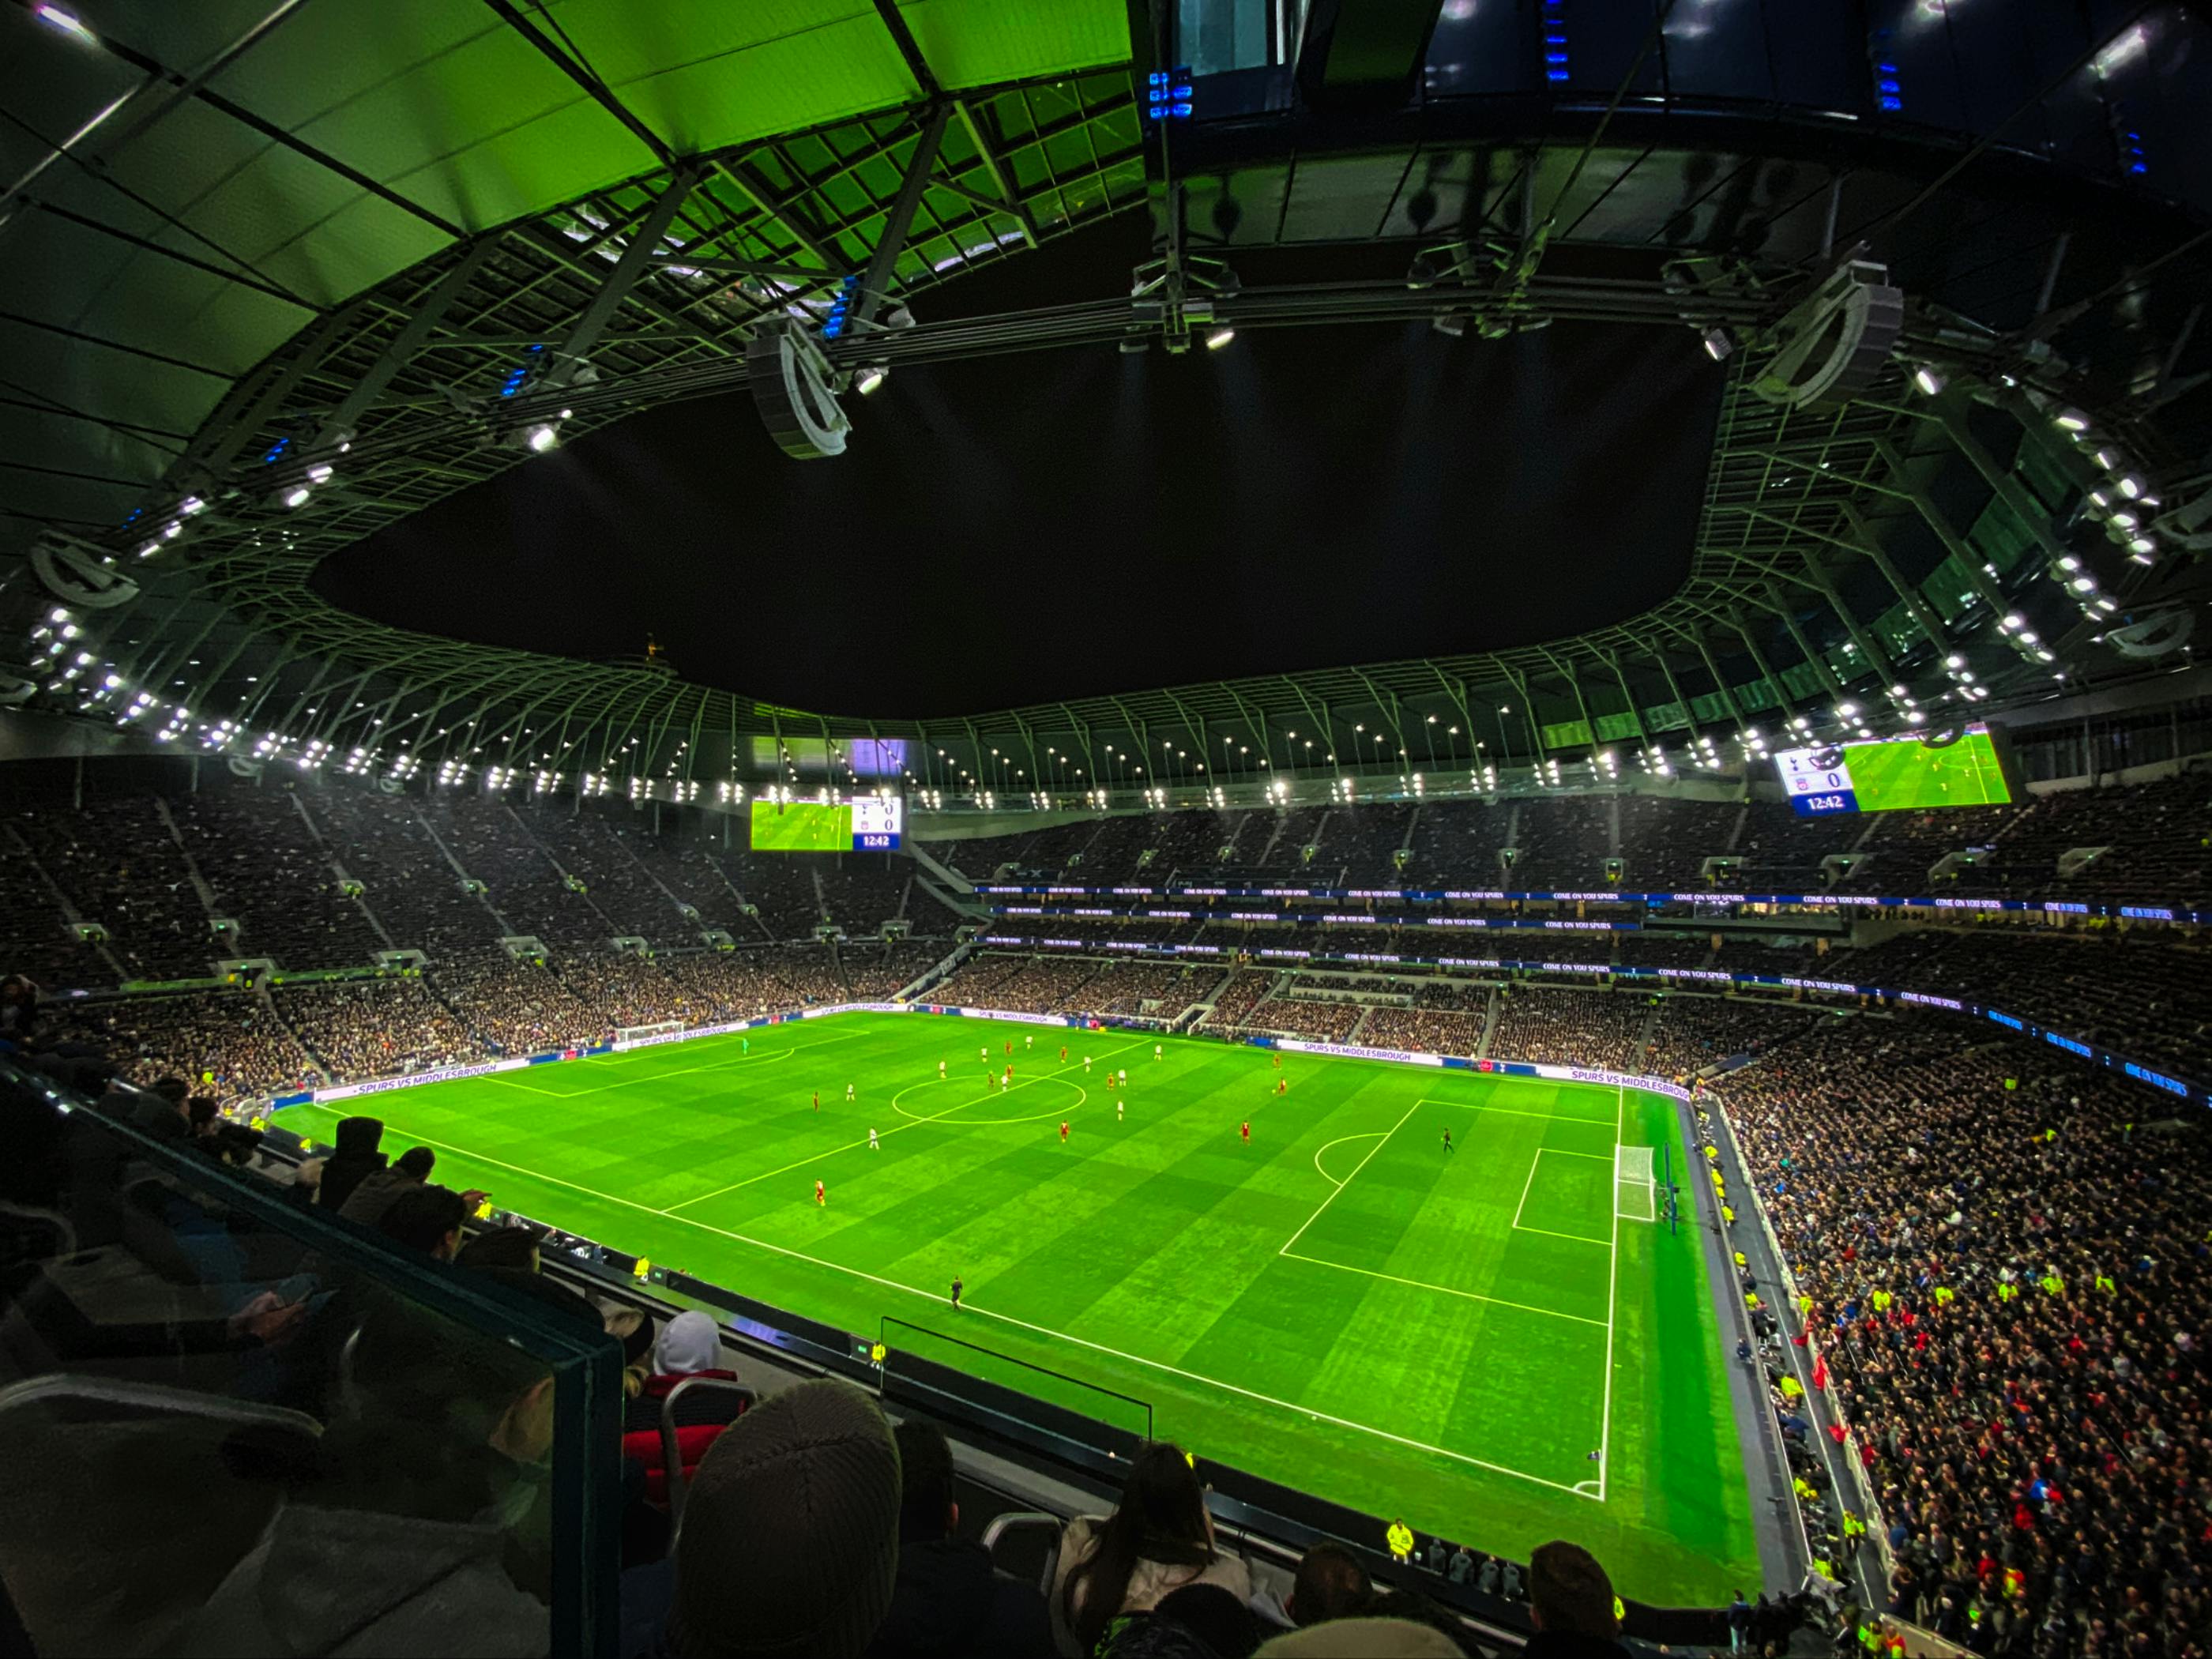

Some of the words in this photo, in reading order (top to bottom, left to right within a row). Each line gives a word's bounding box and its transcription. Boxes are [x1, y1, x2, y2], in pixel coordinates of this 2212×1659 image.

[1828, 773, 1840, 788] 0
[1807, 795, 1845, 810] 12:42
[885, 818, 893, 830] 0
[863, 836, 890, 847] 12:42
[1304, 1043, 1329, 1053] SPURS
[1342, 1047, 1411, 1061] MIDDLESBROUGH
[358, 1080, 395, 1095] SPURS
[397, 1077, 411, 1088] VS
[412, 1064, 497, 1085] MIDDLESBROUGH
[1571, 1070, 1604, 1082] SPURS
[1606, 1074, 1620, 1084] VS
